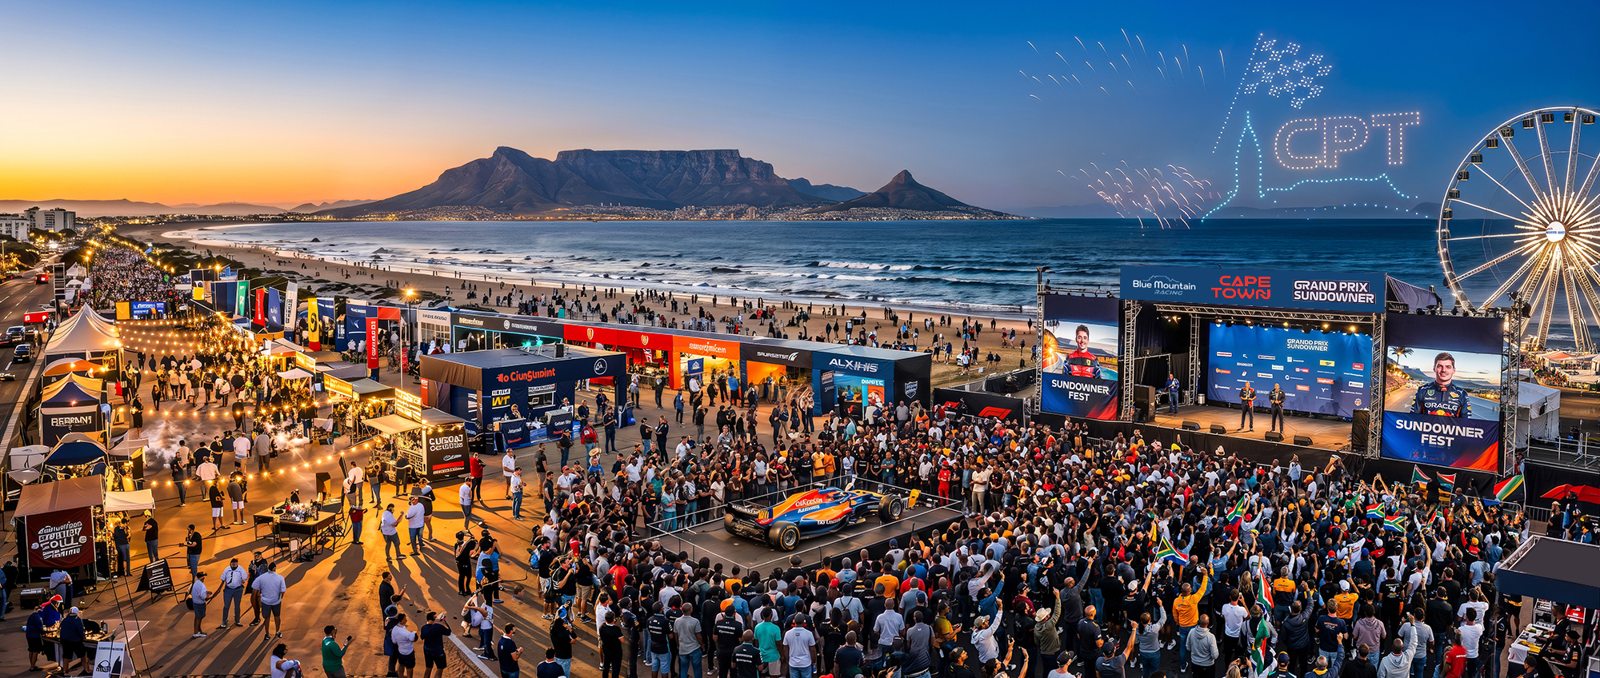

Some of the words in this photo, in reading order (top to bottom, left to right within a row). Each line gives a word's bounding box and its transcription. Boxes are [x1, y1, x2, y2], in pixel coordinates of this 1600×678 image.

[1274, 111, 1419, 169] CPT
[1132, 279, 1152, 289] Blue
[1153, 280, 1197, 291] Mountain
[1218, 275, 1271, 288] CAPE
[1294, 280, 1338, 292] GRAND
[1340, 282, 1369, 293] PRIX
[1211, 287, 1271, 300] TOWN
[1293, 291, 1375, 304] SUNDOWNER
[1286, 344, 1328, 352] SUNDOWNER
[1051, 379, 1110, 395] SUNDOWNER
[1068, 391, 1090, 402] FEST
[1395, 419, 1484, 439] SUNDOWNER
[1421, 433, 1455, 447] FEST
